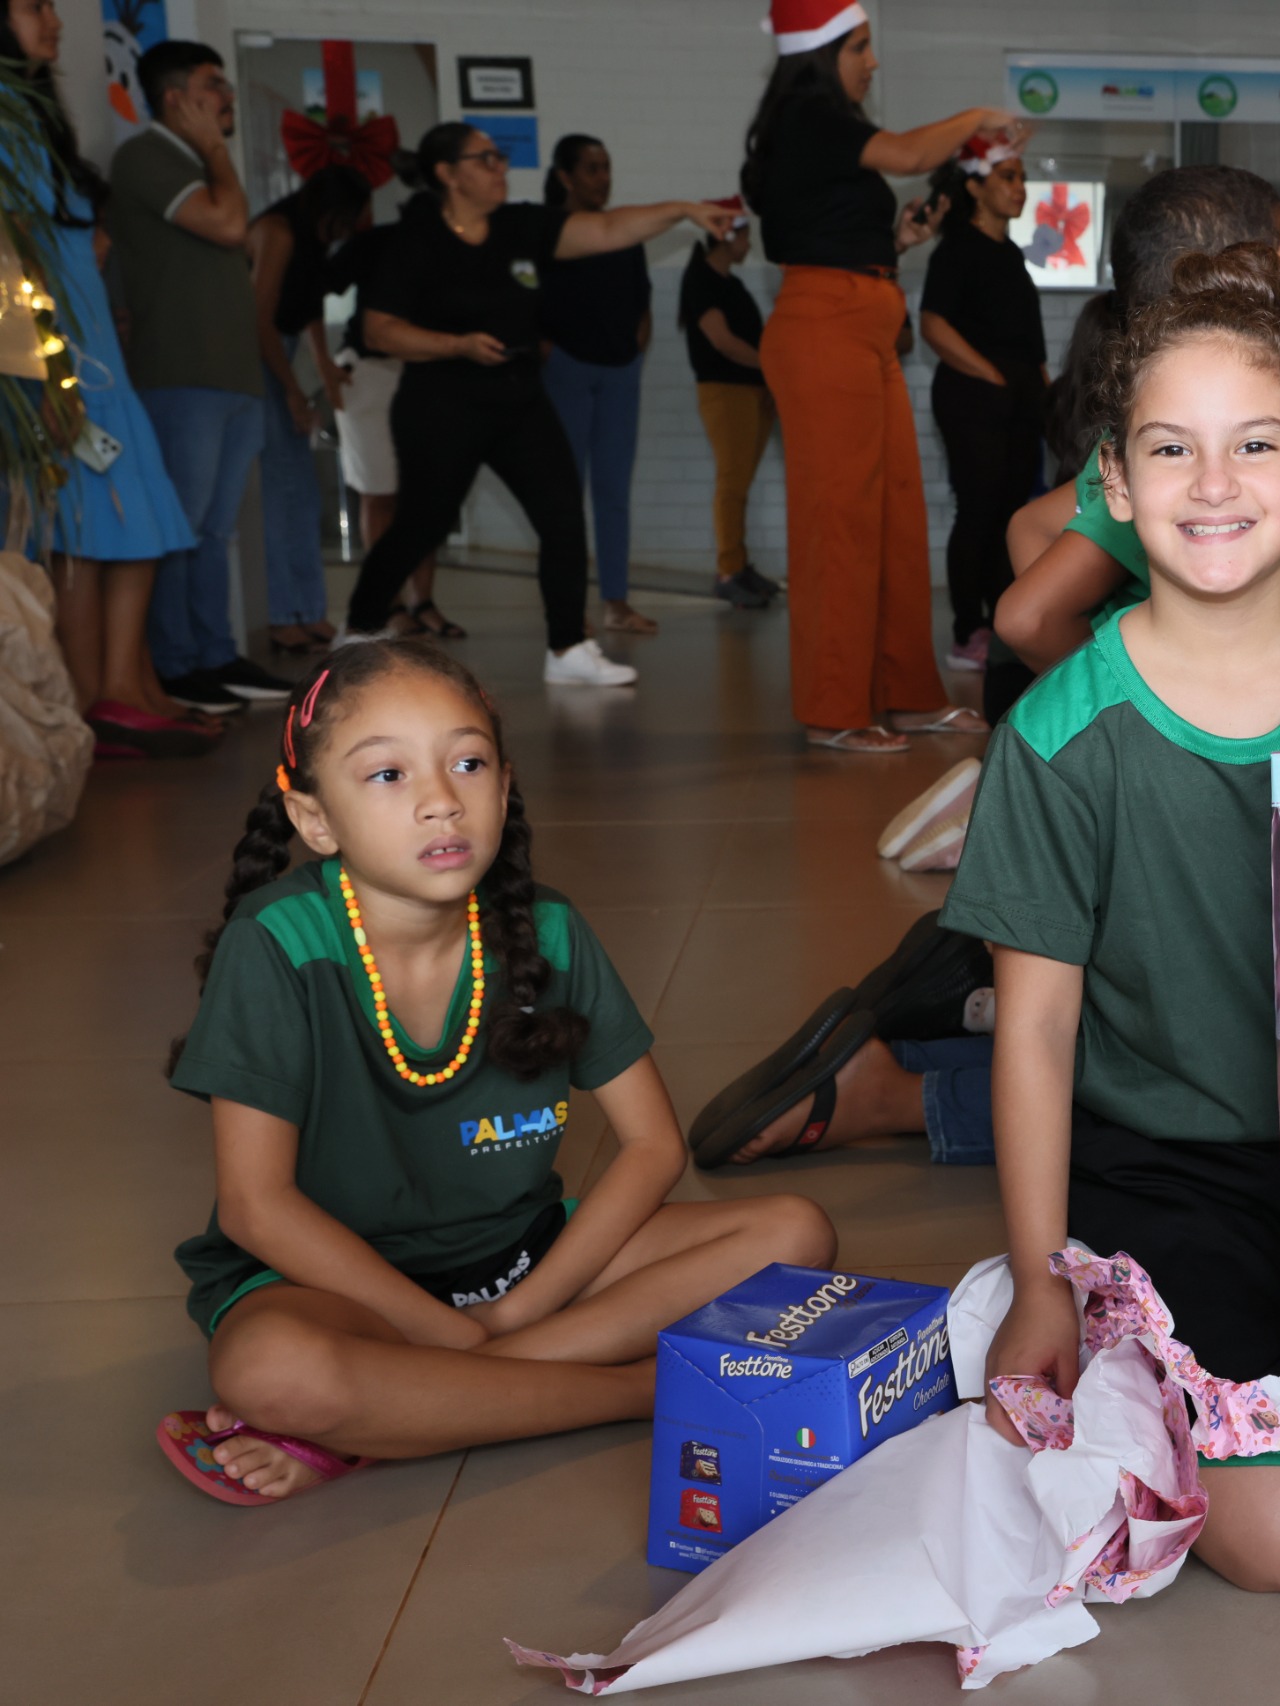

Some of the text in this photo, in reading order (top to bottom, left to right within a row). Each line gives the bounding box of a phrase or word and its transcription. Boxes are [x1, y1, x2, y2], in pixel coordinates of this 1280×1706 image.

[459, 1101, 568, 1147] PALMAS
[470, 1125, 565, 1156] PREFEITURA
[746, 1273, 857, 1348] Festtone
[719, 1353, 793, 1379] Festtone
[858, 1324, 950, 1438] Festtone
[913, 1372, 950, 1410] Chocolate
[693, 1446, 718, 1458] Festtone
